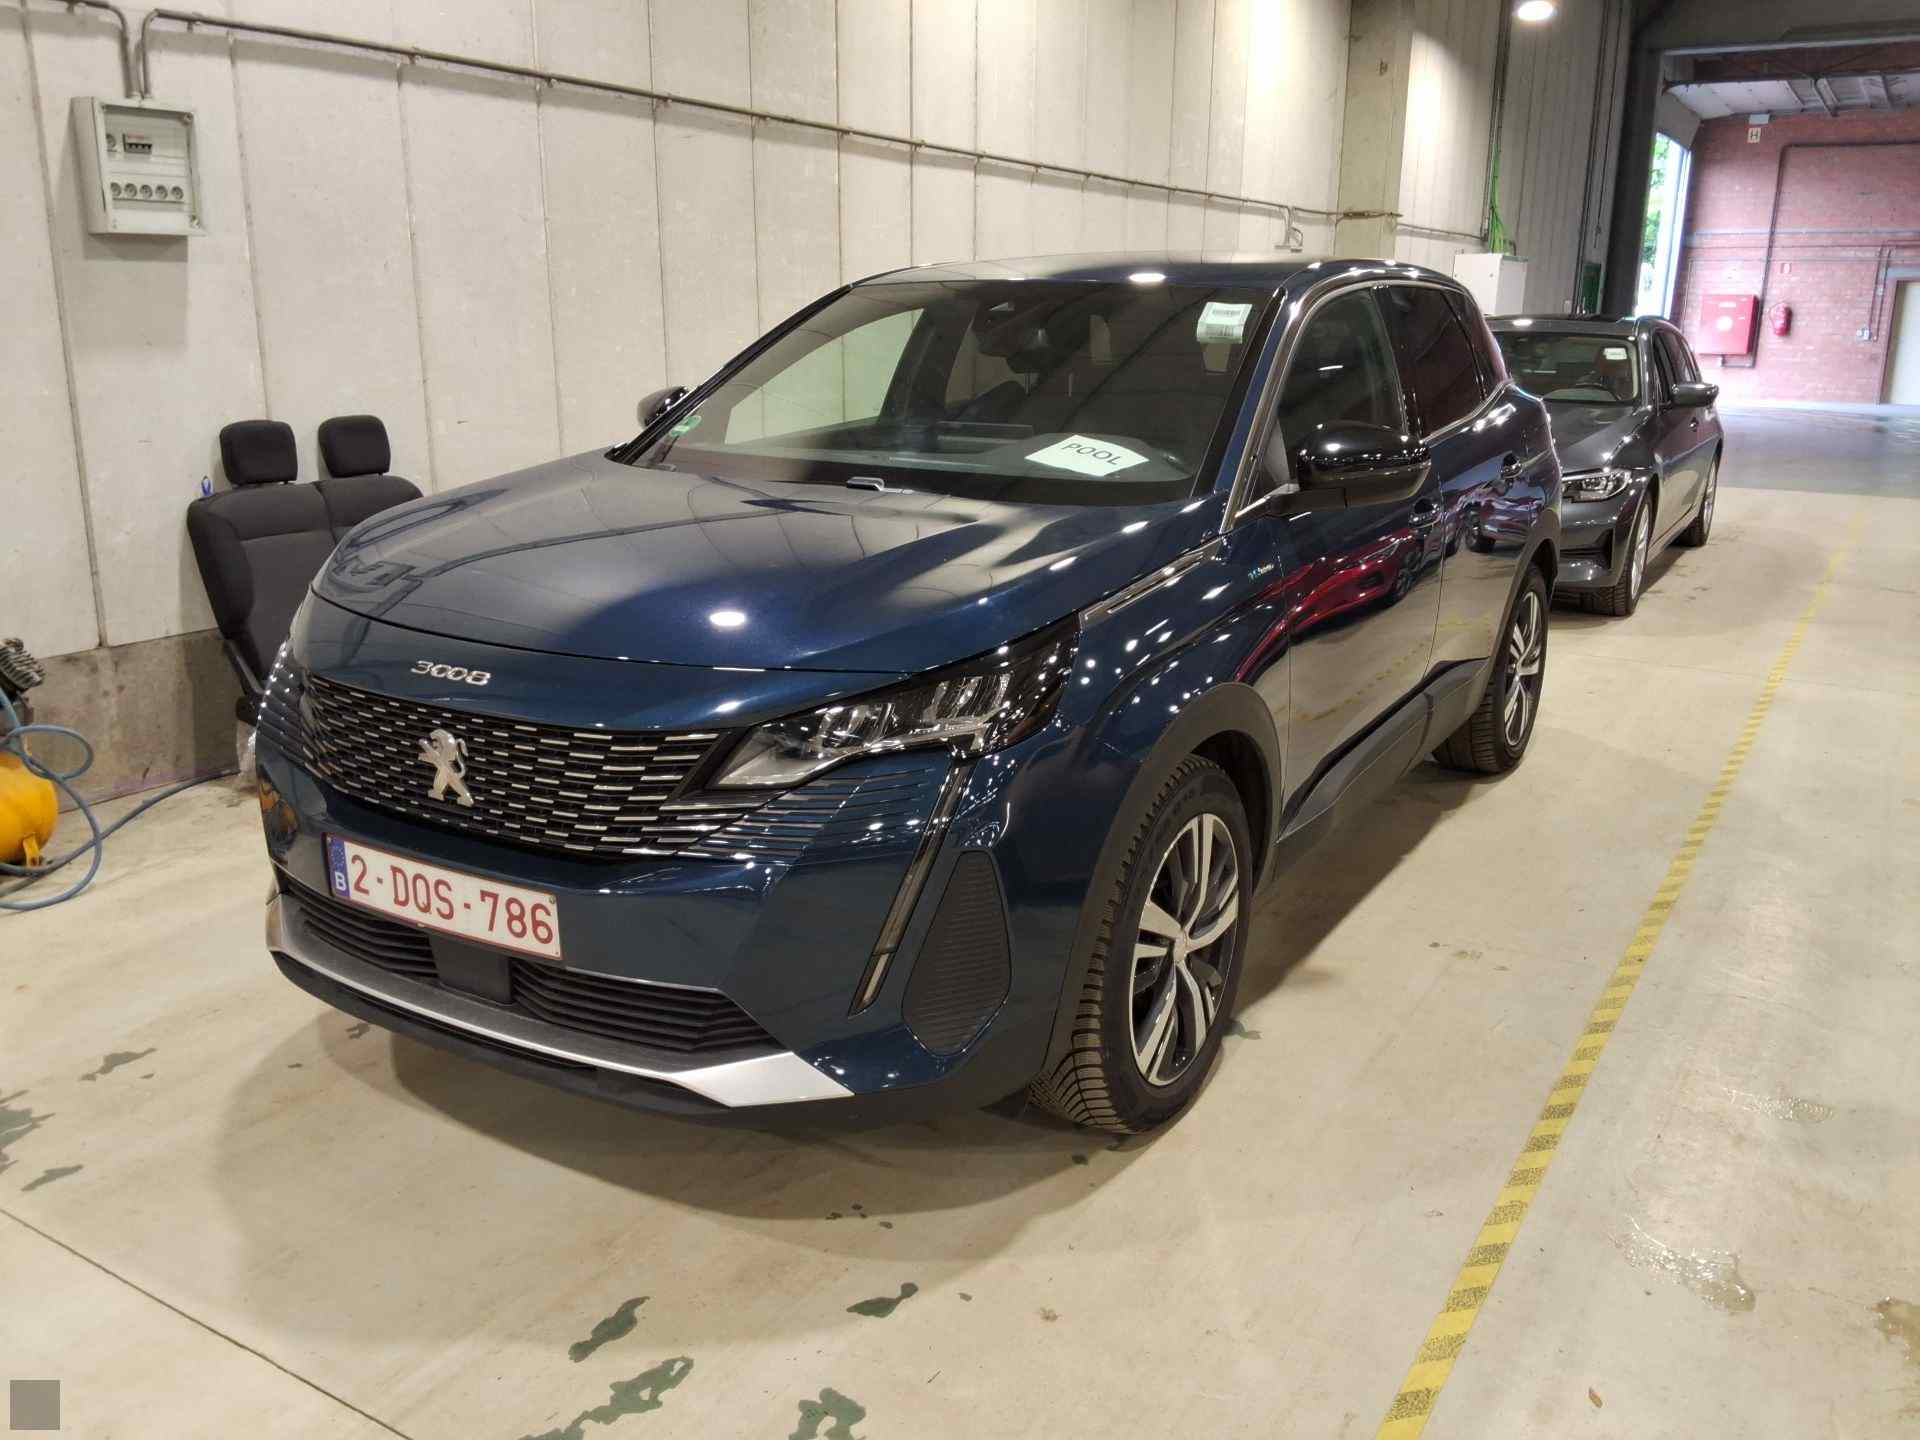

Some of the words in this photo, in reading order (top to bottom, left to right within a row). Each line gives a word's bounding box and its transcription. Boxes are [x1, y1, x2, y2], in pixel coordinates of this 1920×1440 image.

[1061, 443, 1122, 465] POOL
[410, 660, 491, 686] 3008
[334, 871, 347, 891] B
[351, 854, 554, 944] 2-DQS-786
